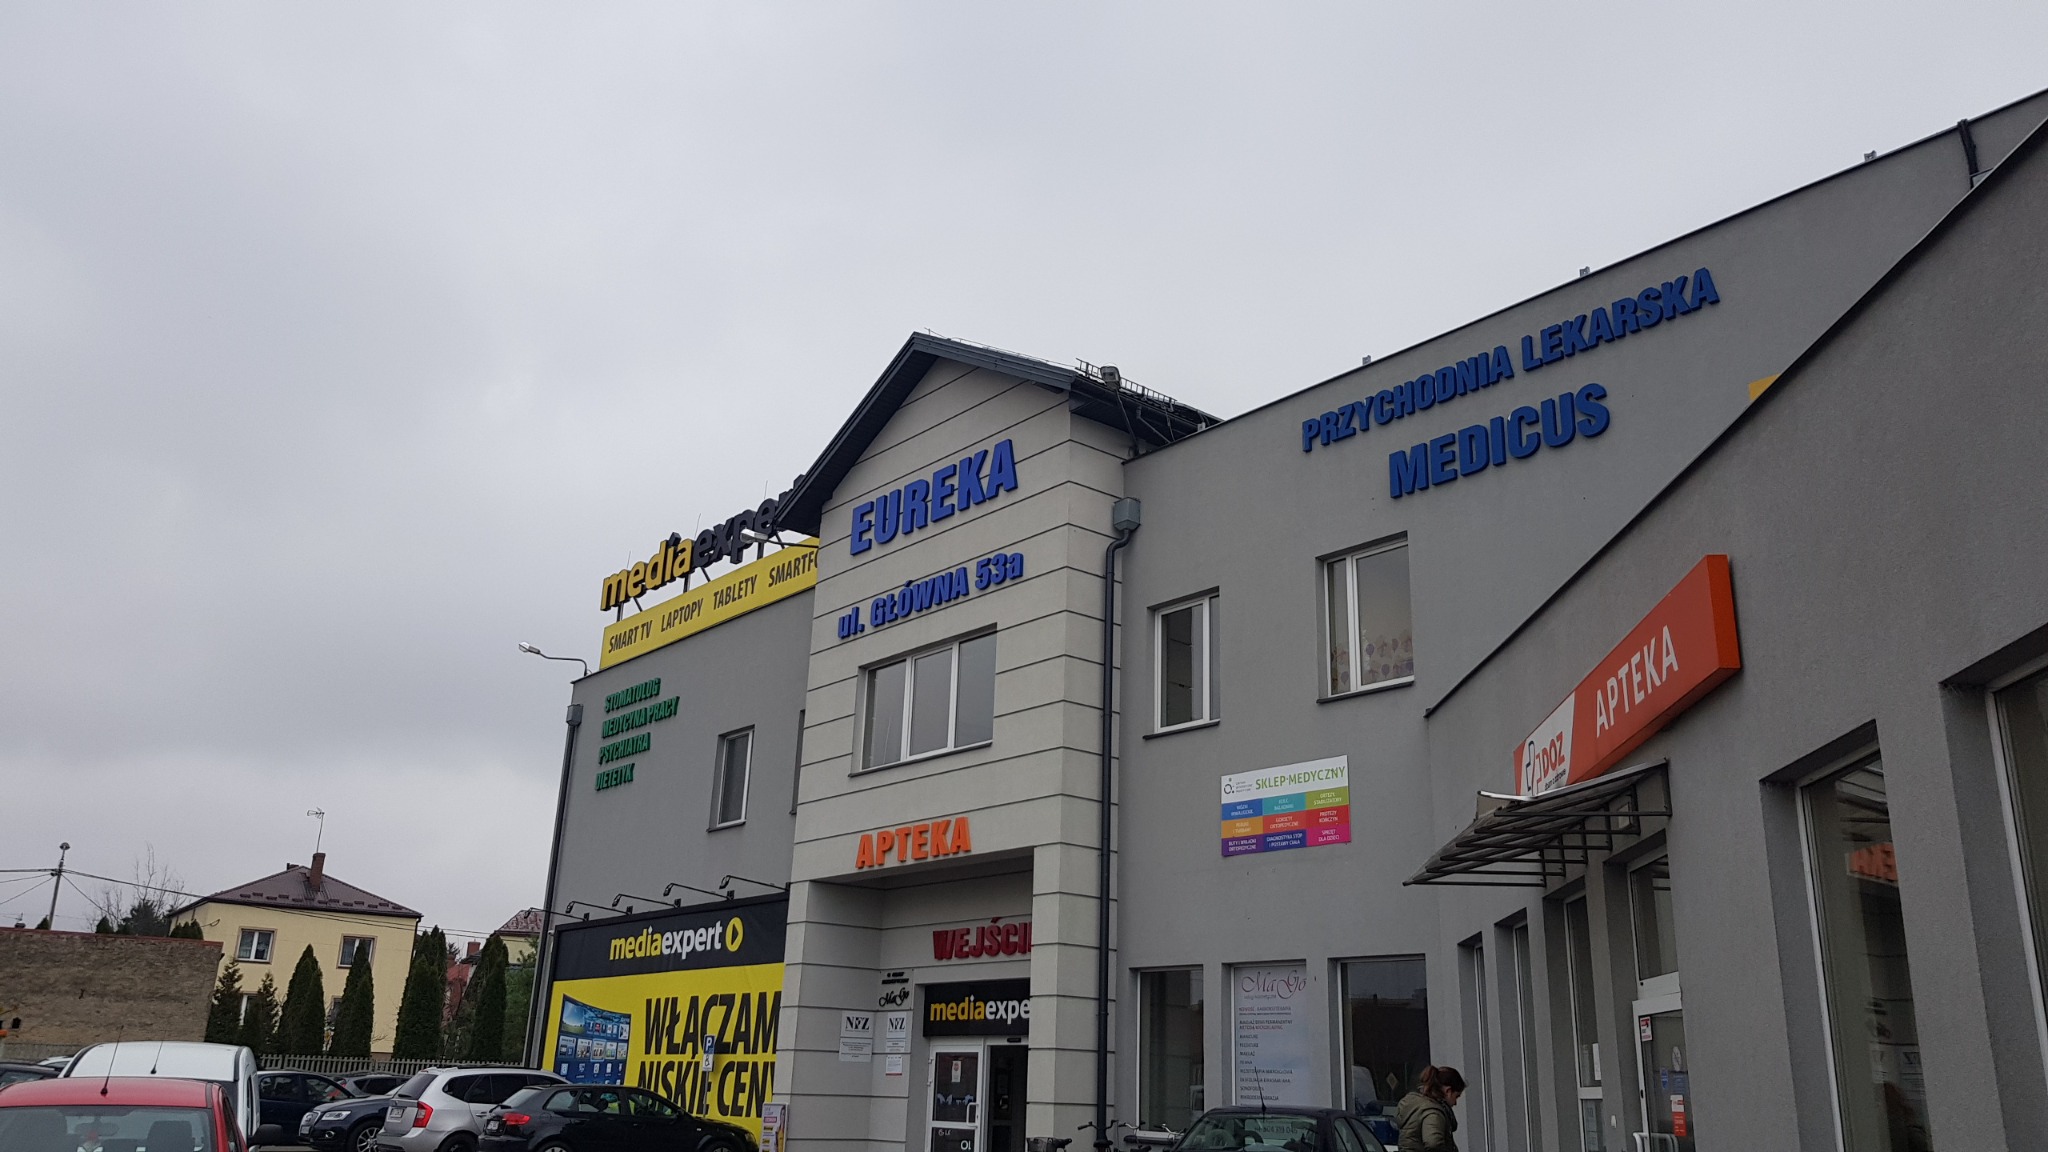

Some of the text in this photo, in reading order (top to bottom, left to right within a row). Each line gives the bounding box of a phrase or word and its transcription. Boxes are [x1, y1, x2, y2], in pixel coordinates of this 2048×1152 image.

[1302, 267, 1720, 453] PRZYCHODNIA LEKARSKA
[1389, 383, 1610, 499] MEDICUS
[850, 438, 1018, 556] EUREKA
[608, 627, 639, 654] SMART
[640, 619, 654, 640] TV
[660, 598, 704, 633] LAPTOPY
[713, 574, 758, 610] TABLETY
[838, 552, 1024, 639] ul. GŁÓWNA 53a
[605, 677, 661, 714] STOMATOLOG
[1596, 625, 1679, 739] APTEKA
[602, 696, 680, 739] MEDYCYNA PRACY
[598, 732, 651, 765] PSYCHIATRA
[1541, 730, 1566, 775] DOZ
[595, 763, 635, 792] DIETETYK
[1255, 775, 1286, 790] SKLEP
[1289, 766, 1346, 786] MEDYCZNY
[855, 816, 972, 870] APTEKA
[609, 920, 723, 960] mediaexpert
[932, 916, 1032, 961] WEJŚCI
[645, 990, 782, 1060] WŁĄCZAM
[705, 1037, 713, 1051] P
[845, 1016, 870, 1031] NFZ
[888, 1017, 906, 1031] NFZ
[717, 1061, 776, 1118] CEN
